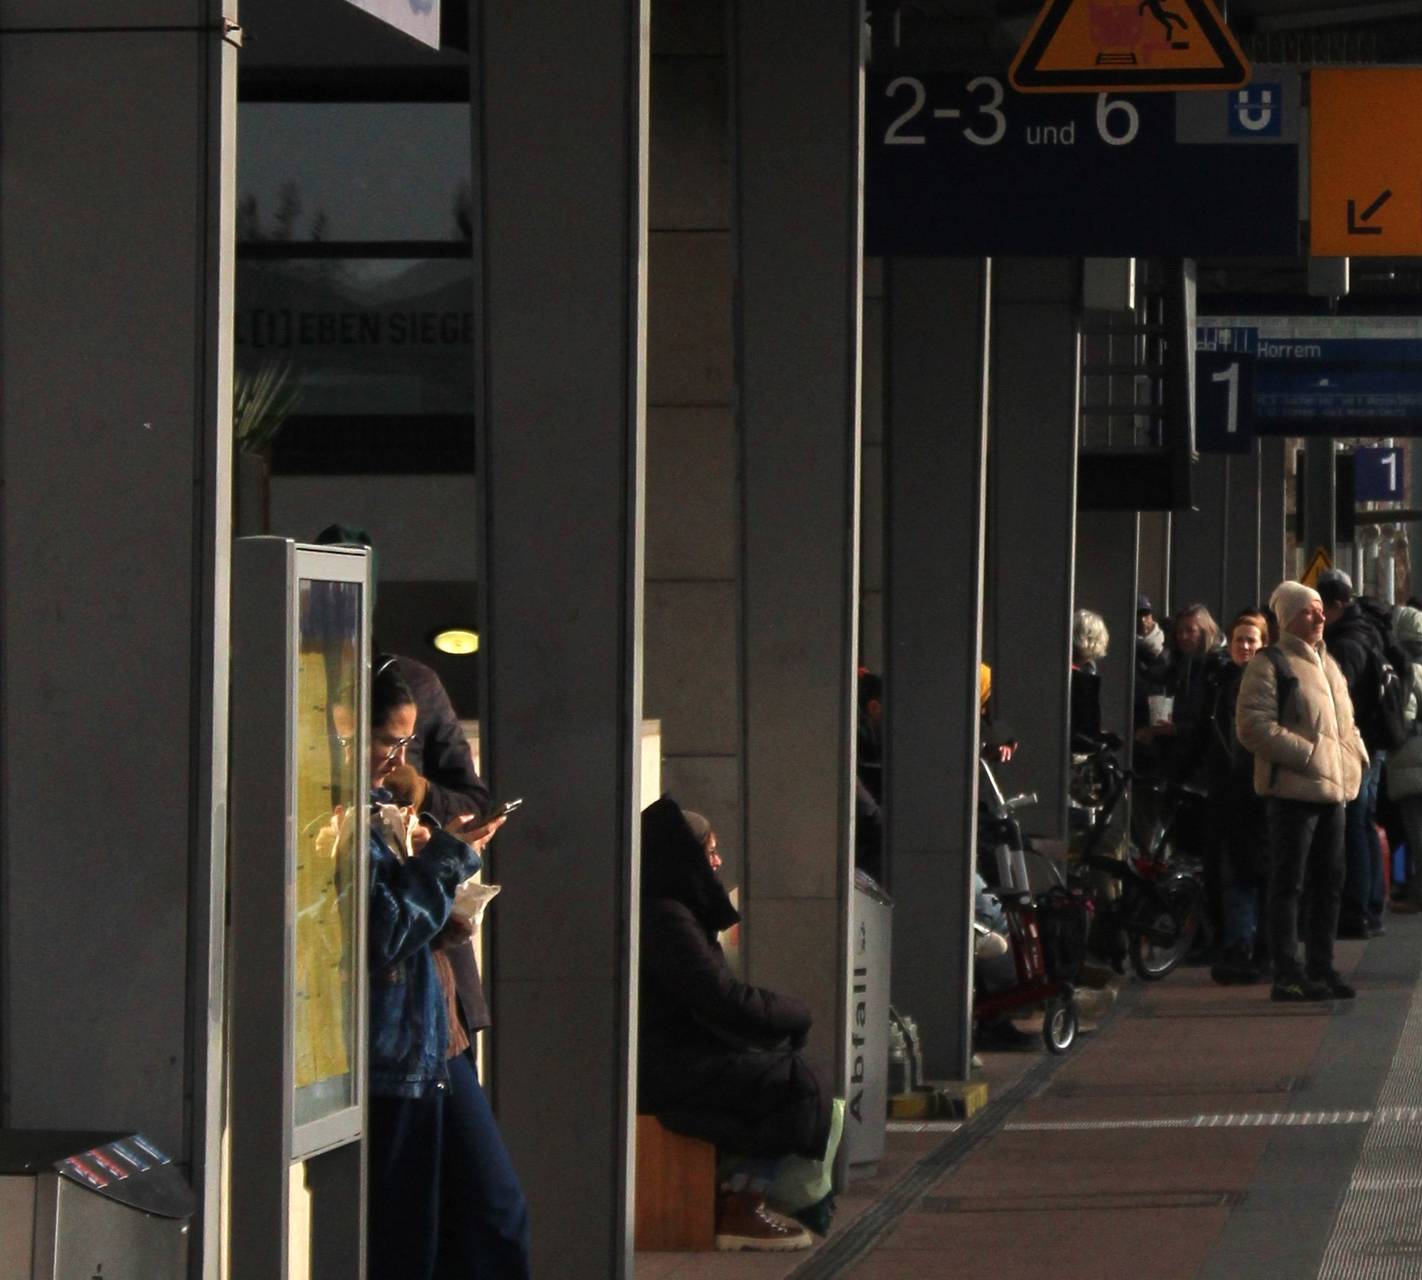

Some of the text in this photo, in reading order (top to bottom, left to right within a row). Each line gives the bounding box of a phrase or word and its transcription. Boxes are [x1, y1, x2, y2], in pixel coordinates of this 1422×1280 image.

[883, 76, 1140, 146] 2-3 und 6
[1257, 342, 1322, 359] Horrem
[1211, 361, 1240, 434] 1
[1381, 452, 1397, 492] 1
[851, 967, 867, 1125] Abfall
